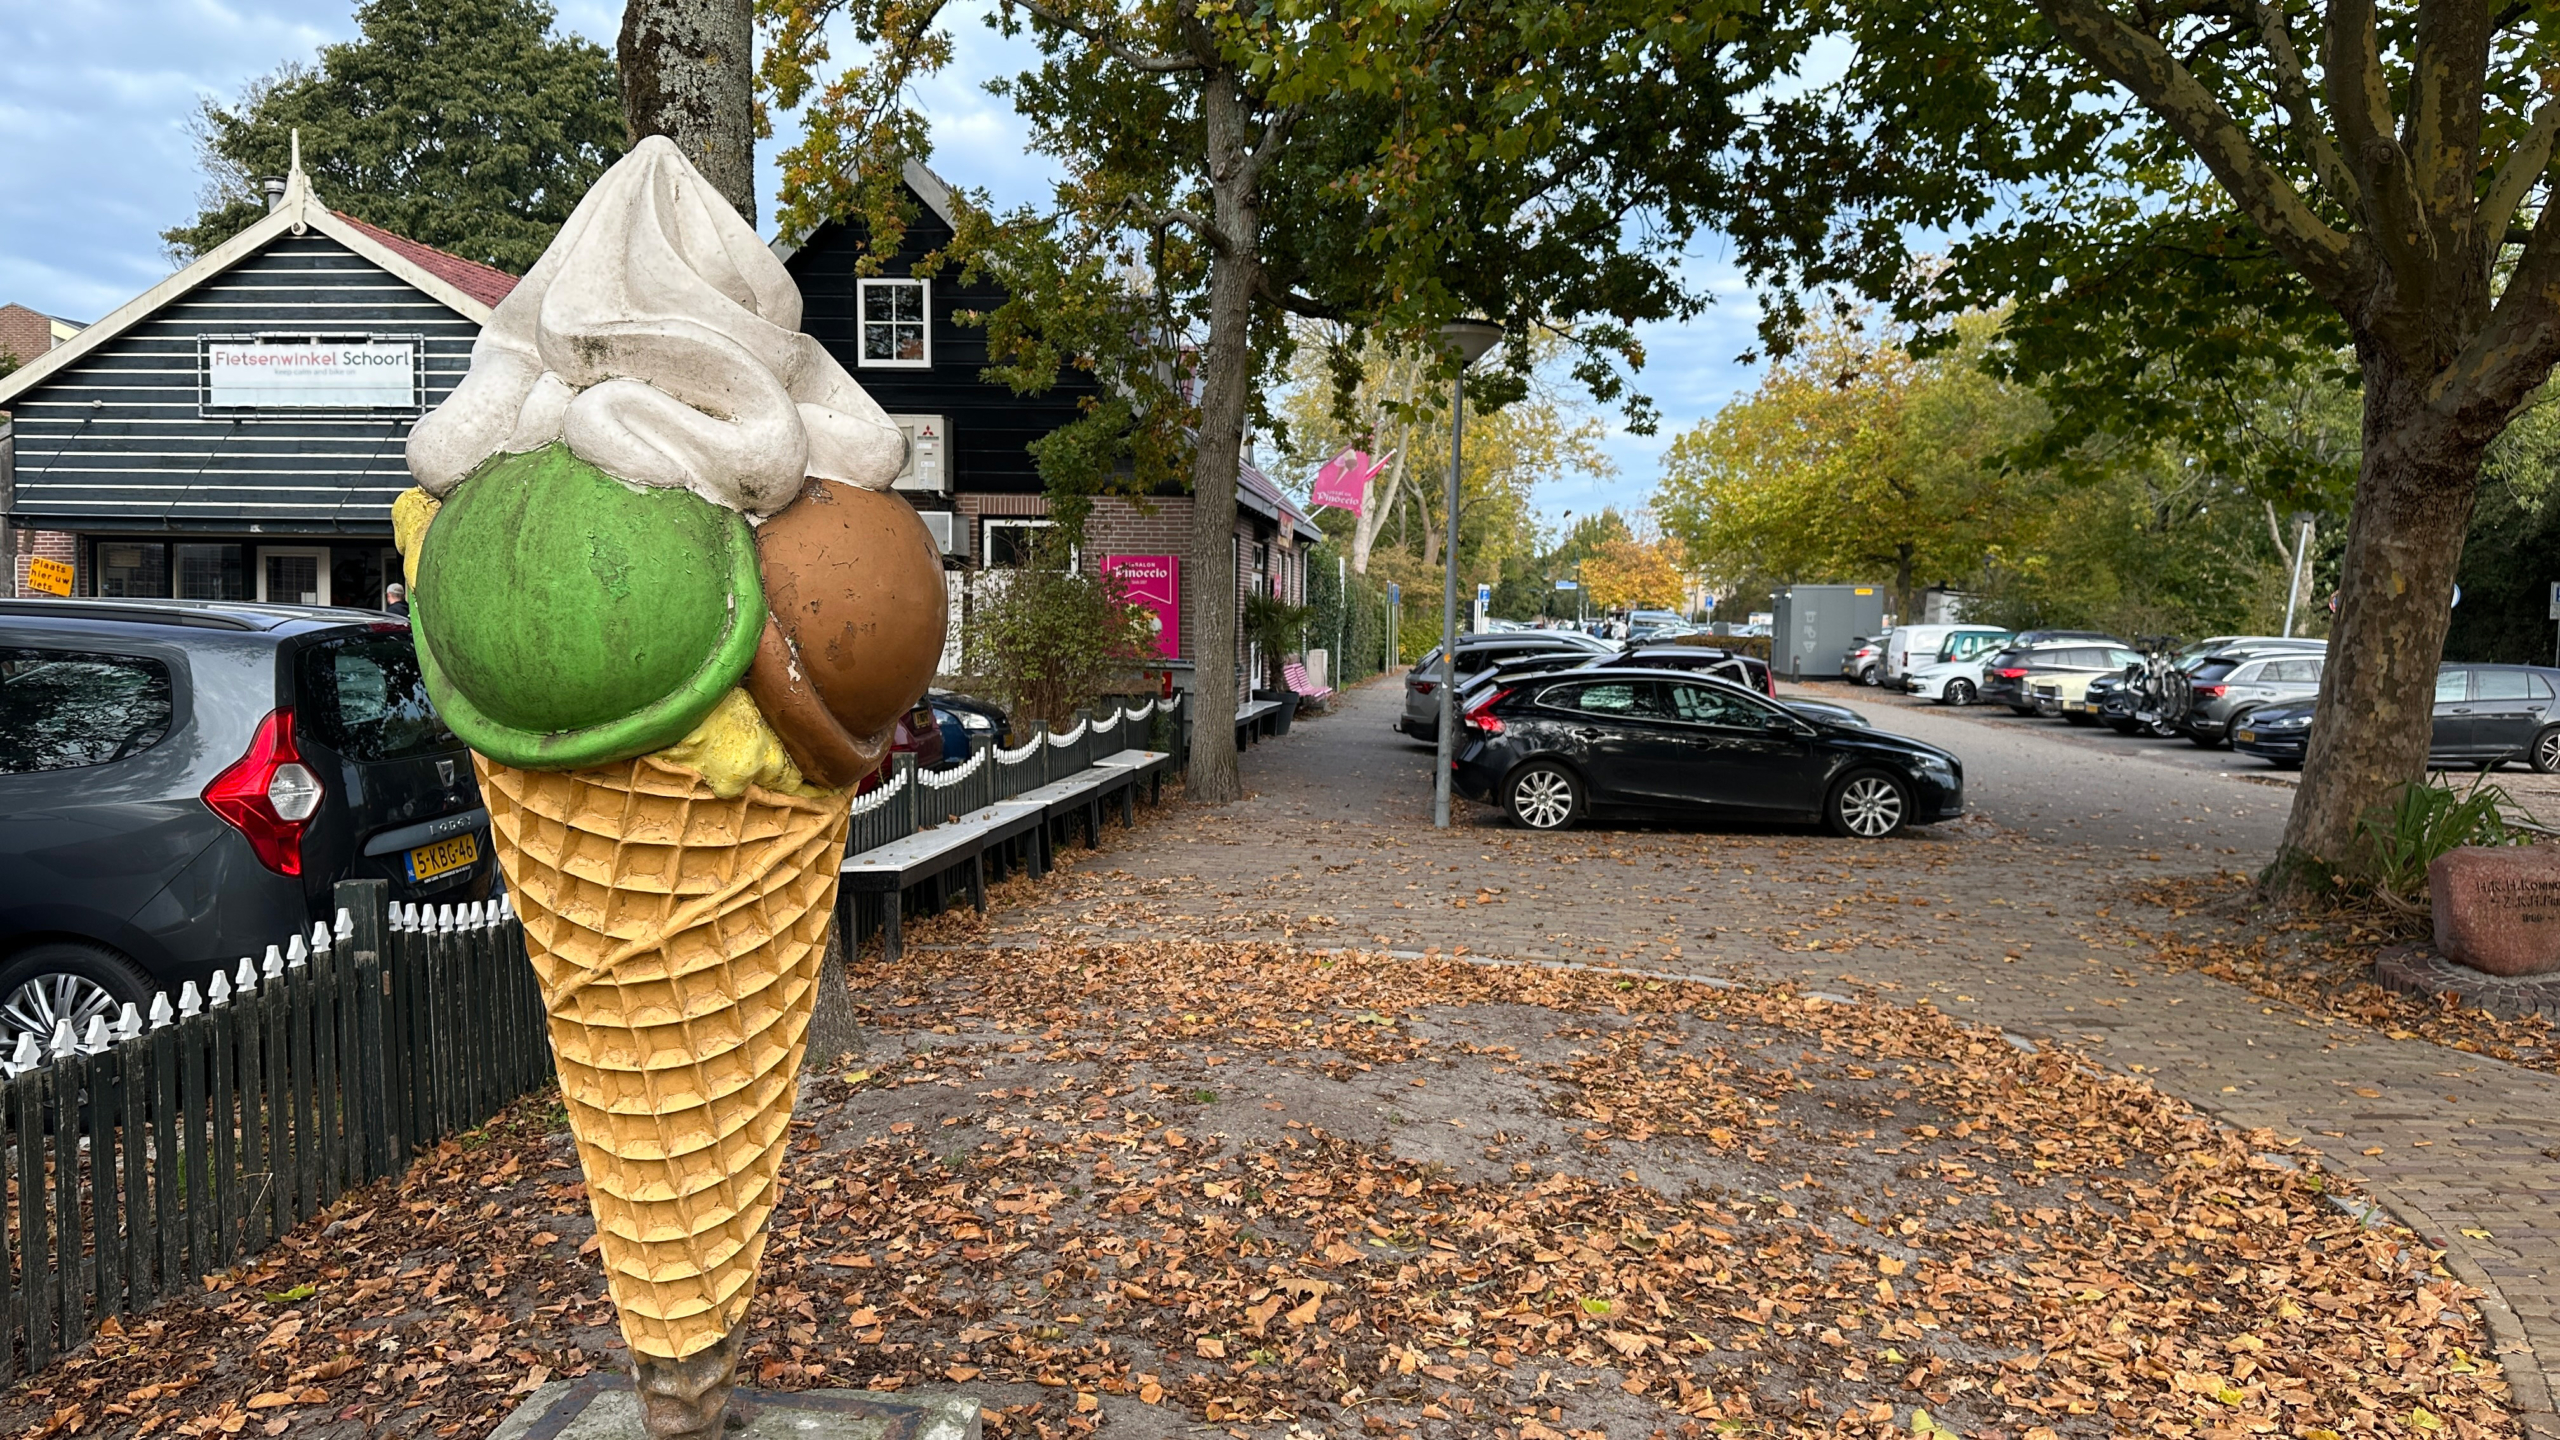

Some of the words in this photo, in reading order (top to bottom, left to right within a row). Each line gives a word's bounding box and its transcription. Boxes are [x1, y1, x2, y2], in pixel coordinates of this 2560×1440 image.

[215, 351, 337, 366] Fietsenwinkel
[343, 351, 409, 366] Schoorl
[274, 368, 293, 376] keep
[293, 368, 312, 376] calm
[314, 368, 328, 376] and
[329, 368, 344, 376] bike
[1317, 491, 1359, 505] Pinoccio
[33, 558, 66, 573] Plaats
[1112, 564, 1168, 579] Pinoccio
[31, 569, 52, 580] hier
[55, 576, 70, 585] uw
[29, 579, 53, 591] fiets
[429, 815, 471, 836] LODGY
[416, 838, 474, 875] 5-KBG-46
